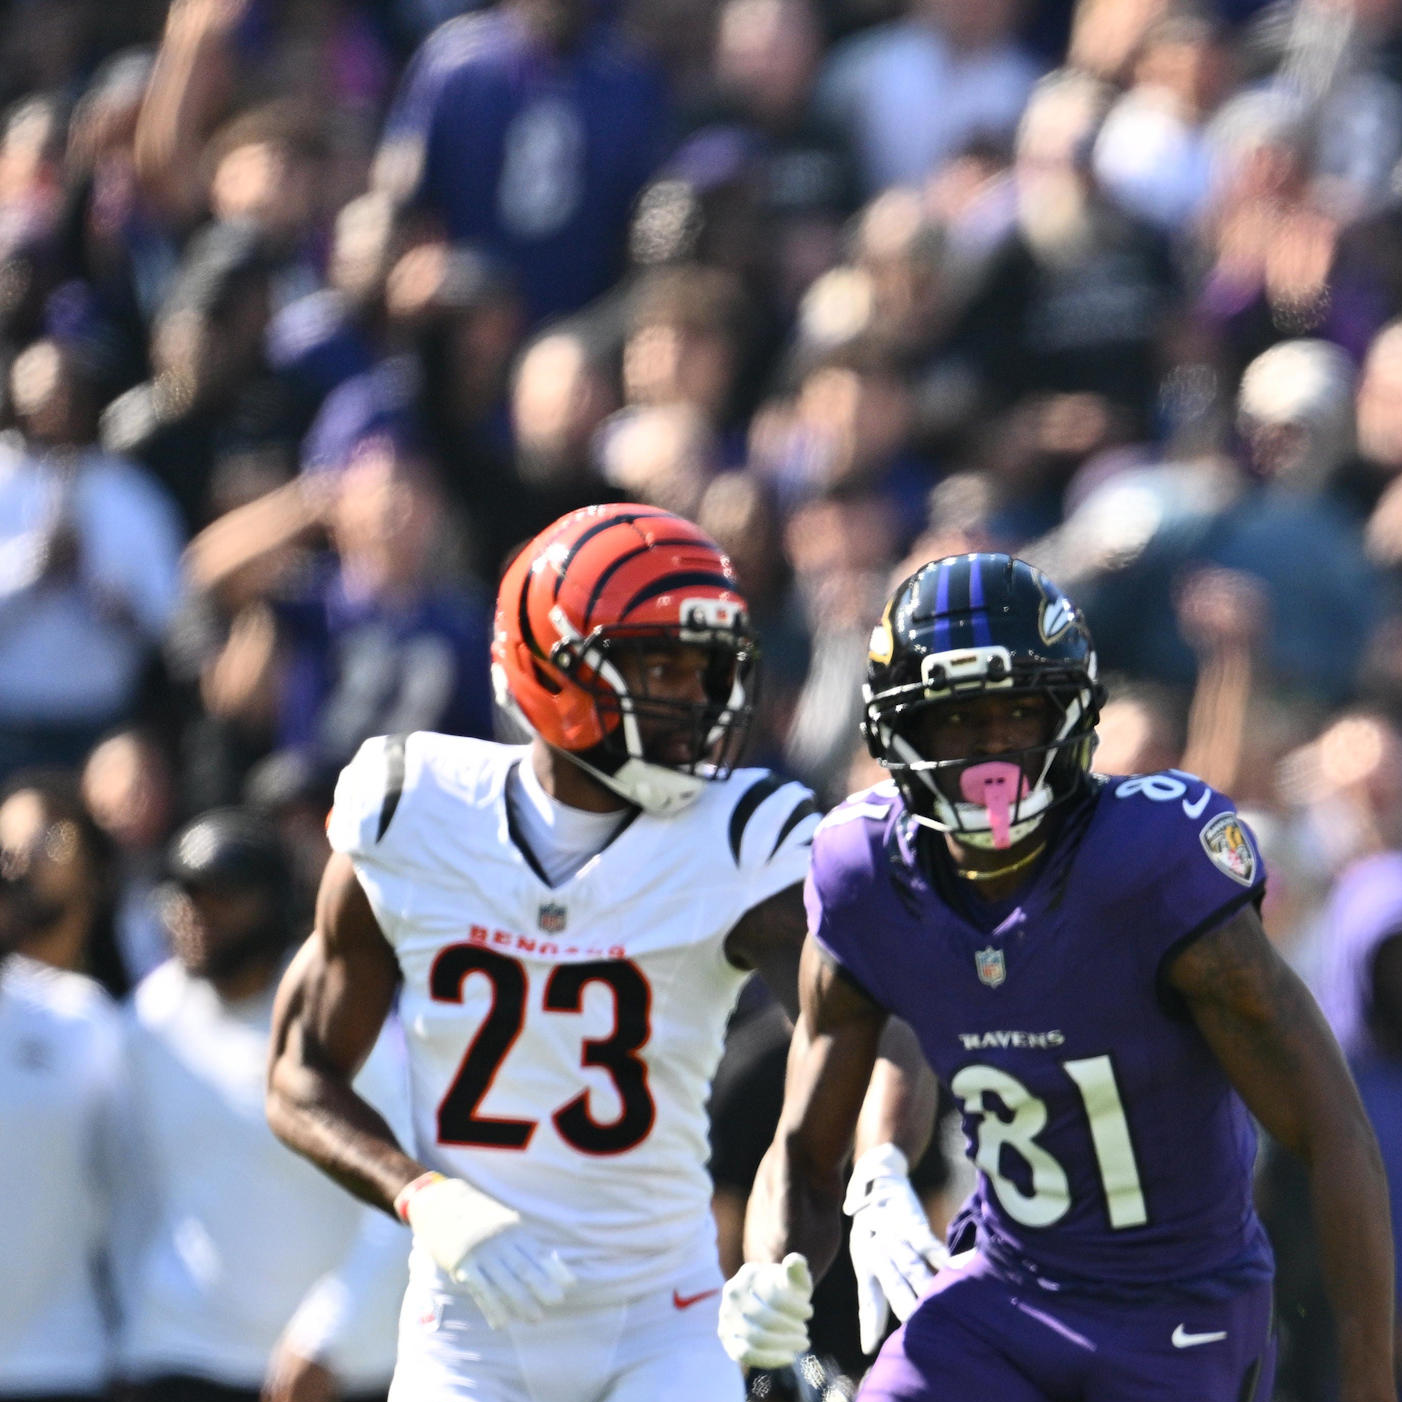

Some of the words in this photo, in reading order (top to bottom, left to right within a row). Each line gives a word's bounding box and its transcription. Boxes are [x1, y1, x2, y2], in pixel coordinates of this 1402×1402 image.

[430, 939, 657, 1157] 23
[958, 1029, 1066, 1050] RAVENS
[951, 1054, 1148, 1229] 81
